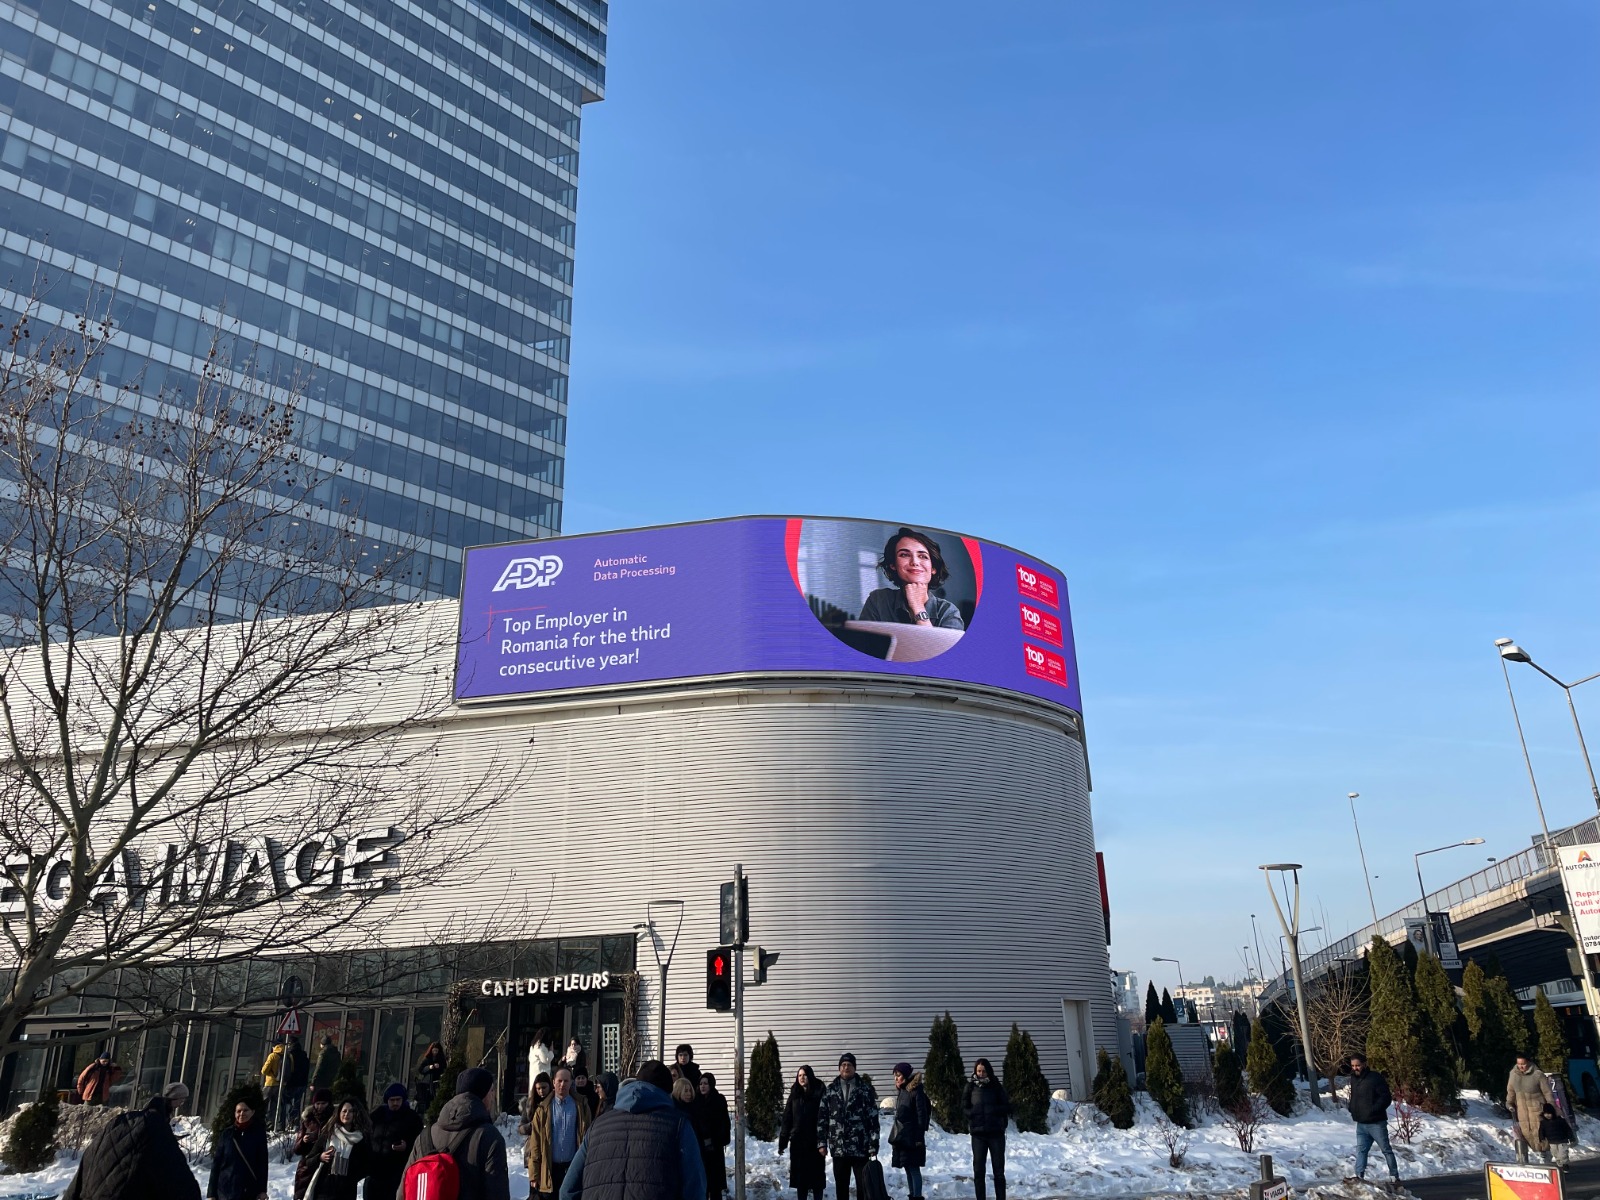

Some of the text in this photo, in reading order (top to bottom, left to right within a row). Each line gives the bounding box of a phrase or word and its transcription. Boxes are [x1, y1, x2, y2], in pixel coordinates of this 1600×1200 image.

[594, 554, 648, 568] Automatic
[492, 555, 563, 592] ADP
[593, 565, 676, 581] Data Processing
[1018, 567, 1036, 587] top
[503, 607, 628, 635] Top Employer in
[1022, 606, 1040, 626] top
[501, 623, 671, 655] Romania for the third
[499, 648, 640, 677] consecutive year!
[1026, 646, 1044, 666] top
[1565, 862, 1600, 871] AUTOMATI
[528, 977, 549, 994] DE
[554, 971, 609, 993] FLEURS
